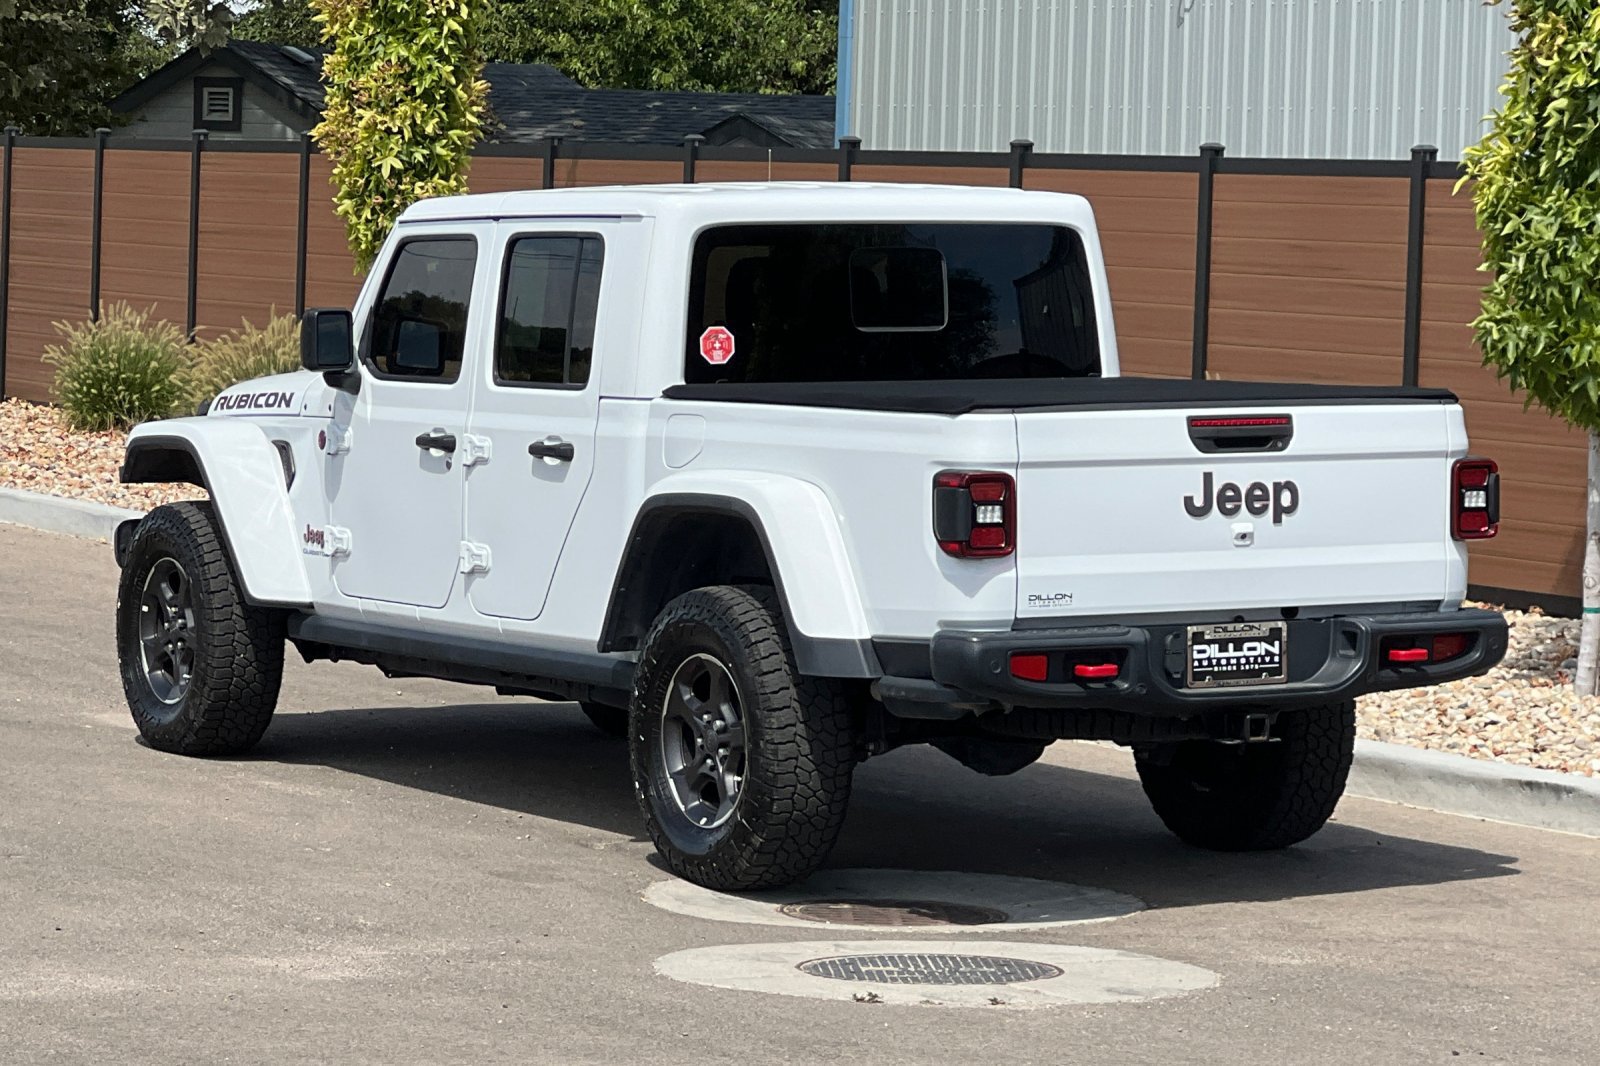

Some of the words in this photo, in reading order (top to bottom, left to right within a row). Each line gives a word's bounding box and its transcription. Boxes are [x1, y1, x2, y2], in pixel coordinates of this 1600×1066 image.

[214, 392, 295, 411] RUBICON
[1183, 471, 1299, 524] Jeep
[1028, 593, 1073, 601] DILLON
[1214, 625, 1261, 633] DILLON
[1193, 641, 1279, 659] DILLON
[1193, 656, 1279, 667] AUTOMOTIVE
